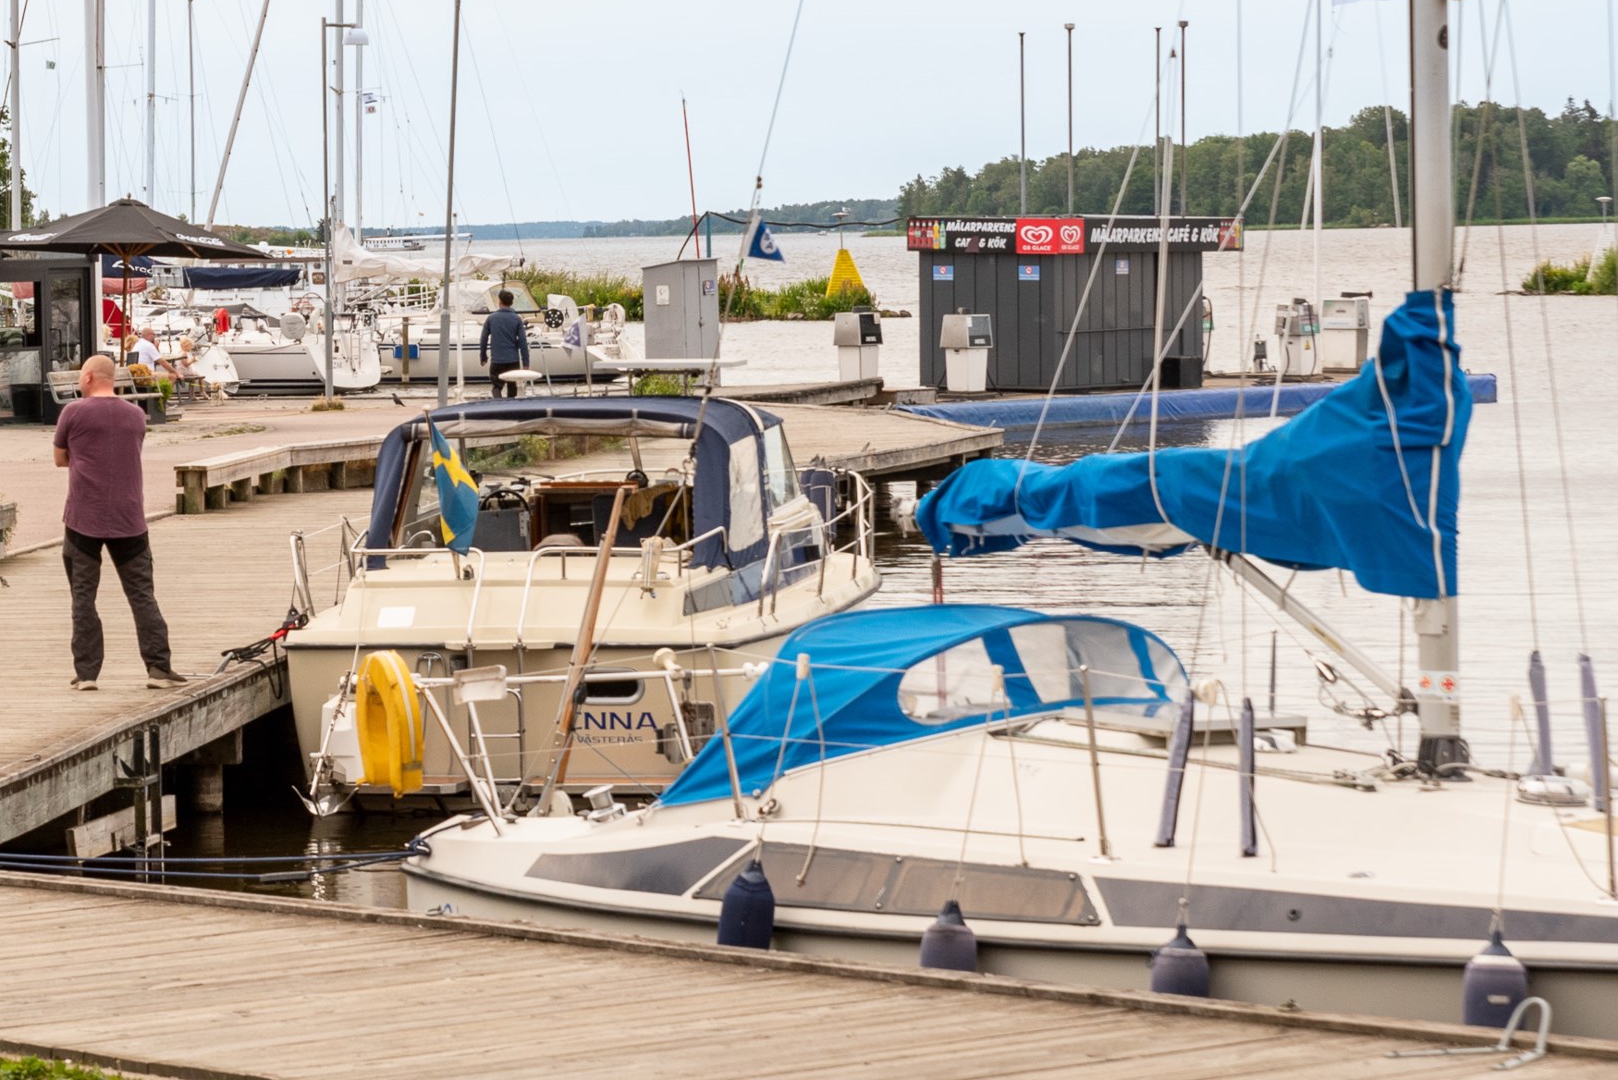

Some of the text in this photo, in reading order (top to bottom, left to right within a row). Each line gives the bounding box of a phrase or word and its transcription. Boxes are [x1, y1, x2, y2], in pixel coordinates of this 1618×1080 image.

[945, 220, 1017, 233] MÄLARPARKENS
[1167, 224, 1190, 242] CAFÉ
[1200, 224, 1220, 243] KÖK
[987, 236, 1007, 249] KÖK
